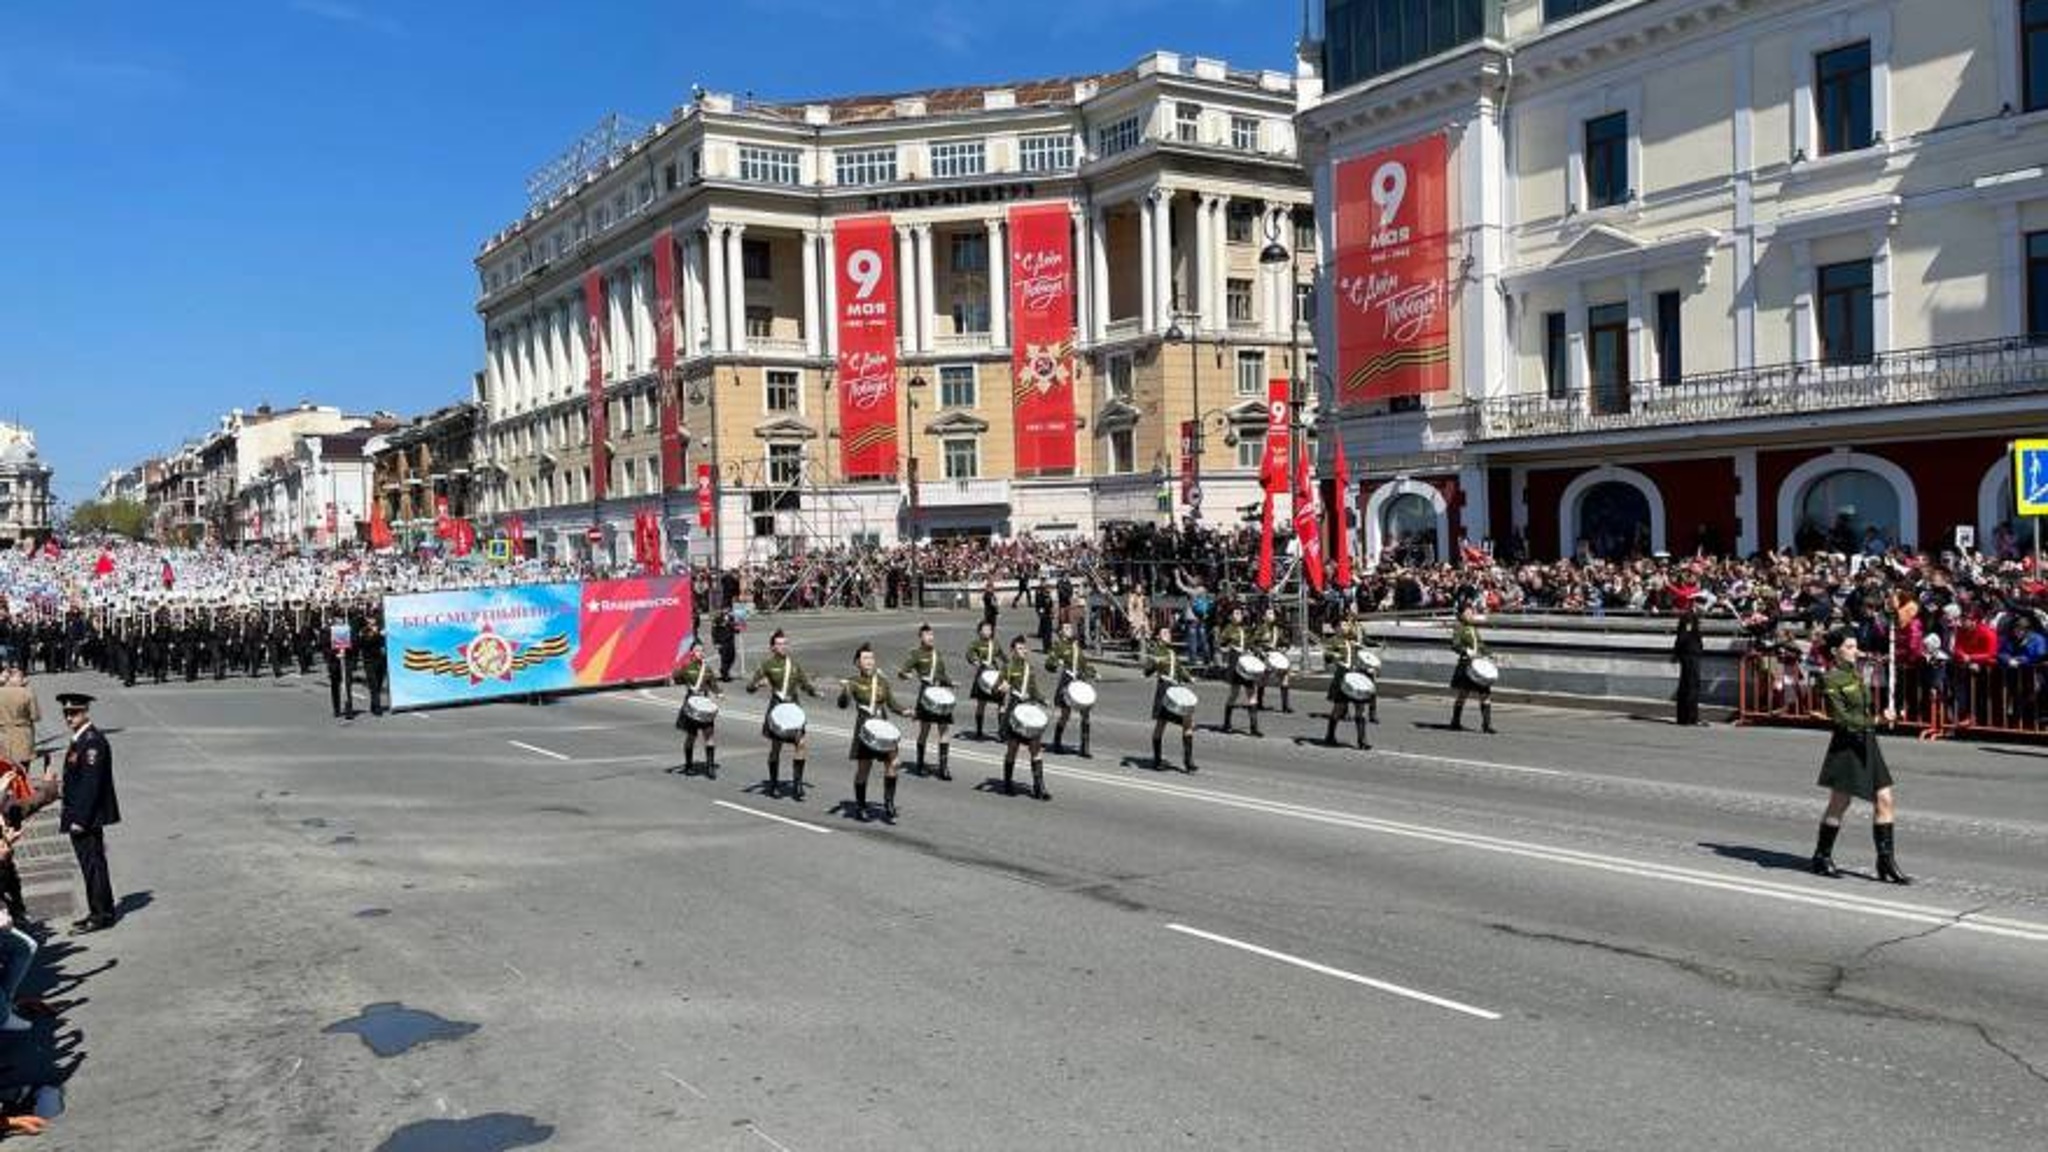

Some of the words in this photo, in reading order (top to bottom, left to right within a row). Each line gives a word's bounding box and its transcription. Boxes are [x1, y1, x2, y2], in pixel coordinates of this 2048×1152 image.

[1371, 161, 1407, 226] 9
[847, 248, 882, 299] 9
[1272, 401, 1286, 424] 9
